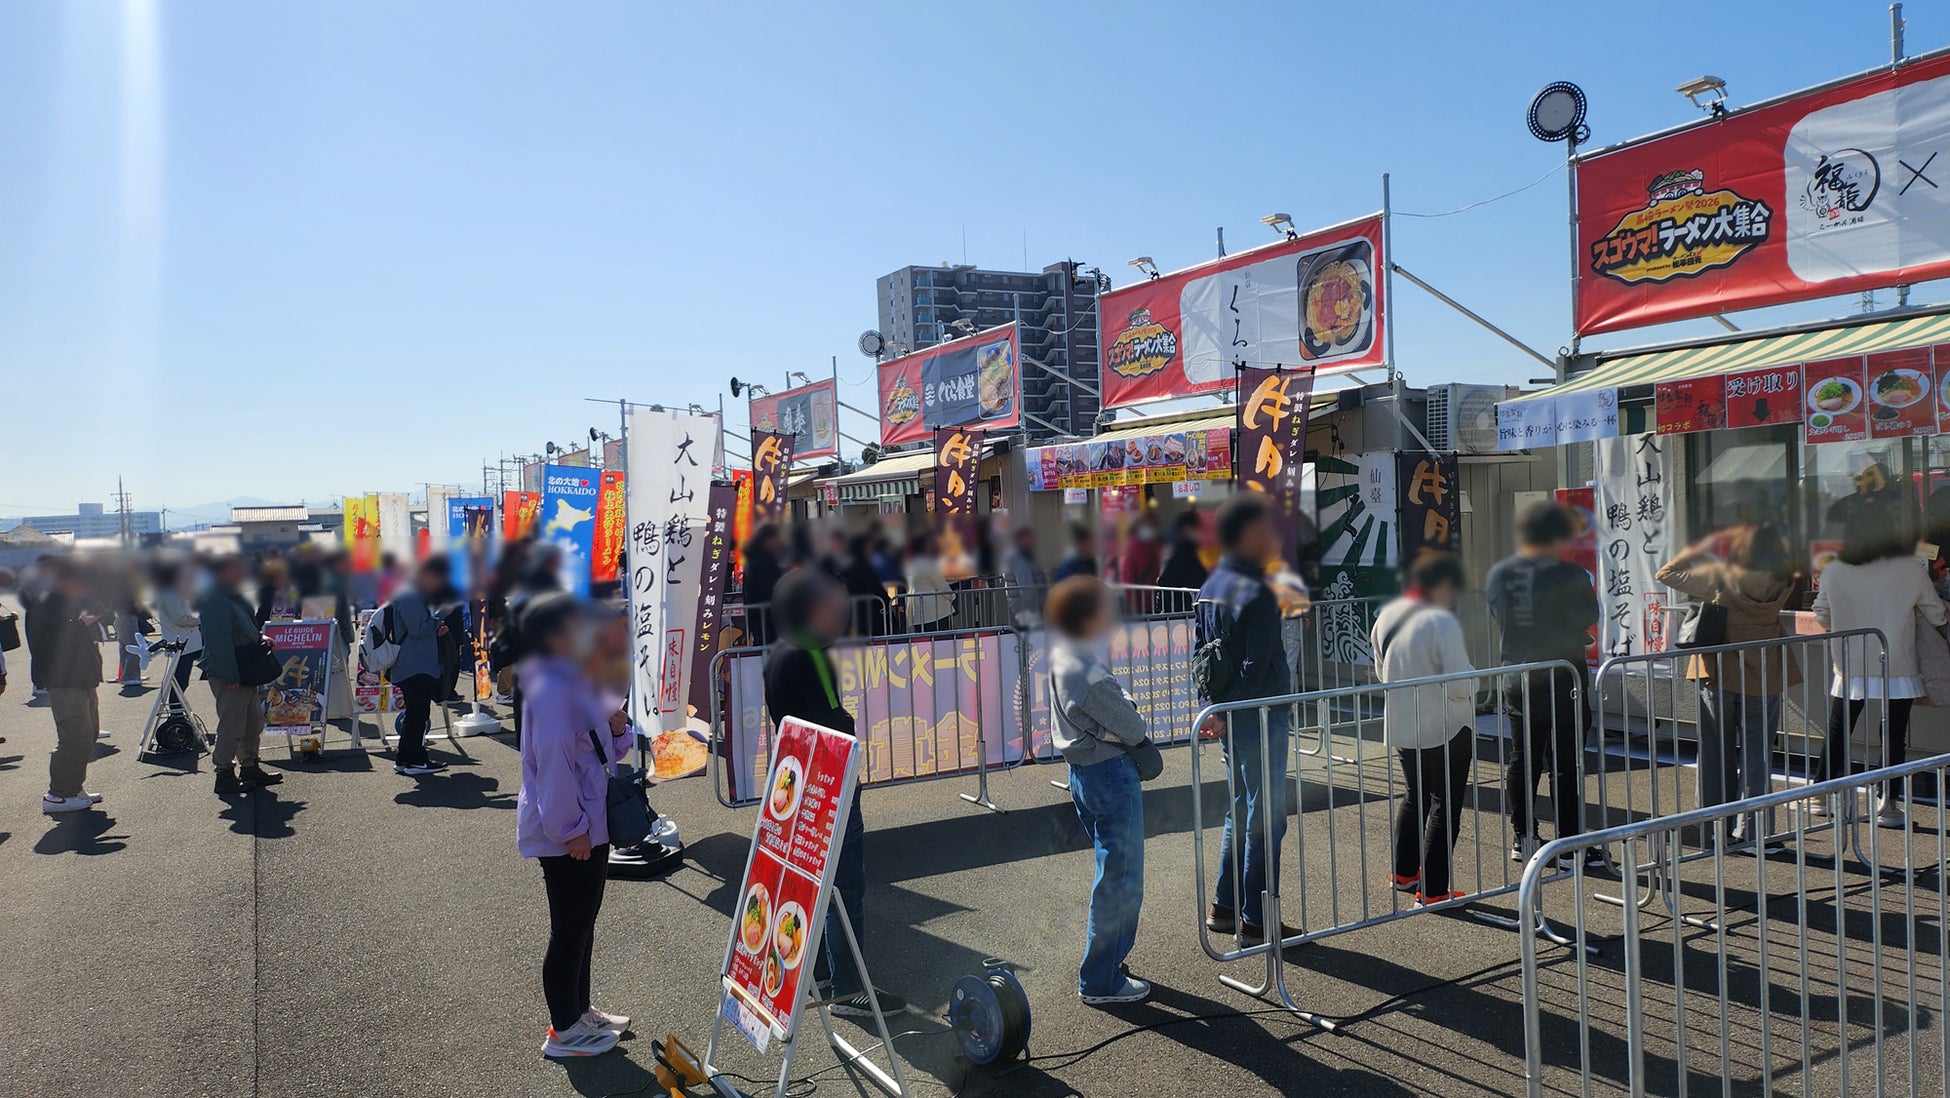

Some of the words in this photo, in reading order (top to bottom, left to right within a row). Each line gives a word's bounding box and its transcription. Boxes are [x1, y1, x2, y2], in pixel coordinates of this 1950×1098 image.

[1727, 370, 1798, 399] 受け取り
[1499, 423, 1552, 441] 旨味と香りが
[1556, 414, 1617, 433] 心に染みる一杯
[547, 486, 597, 496] HOKKAIDO
[548, 476, 580, 487] 北の大地
[664, 430, 699, 585] 大山鶏と
[700, 506, 727, 652] 特製ねぎダレ・刻みレモン
[1606, 501, 1637, 657] 鴨の塩そば
[275, 633, 323, 643] MICHELIN
[1647, 599, 1665, 653] 味自慢
